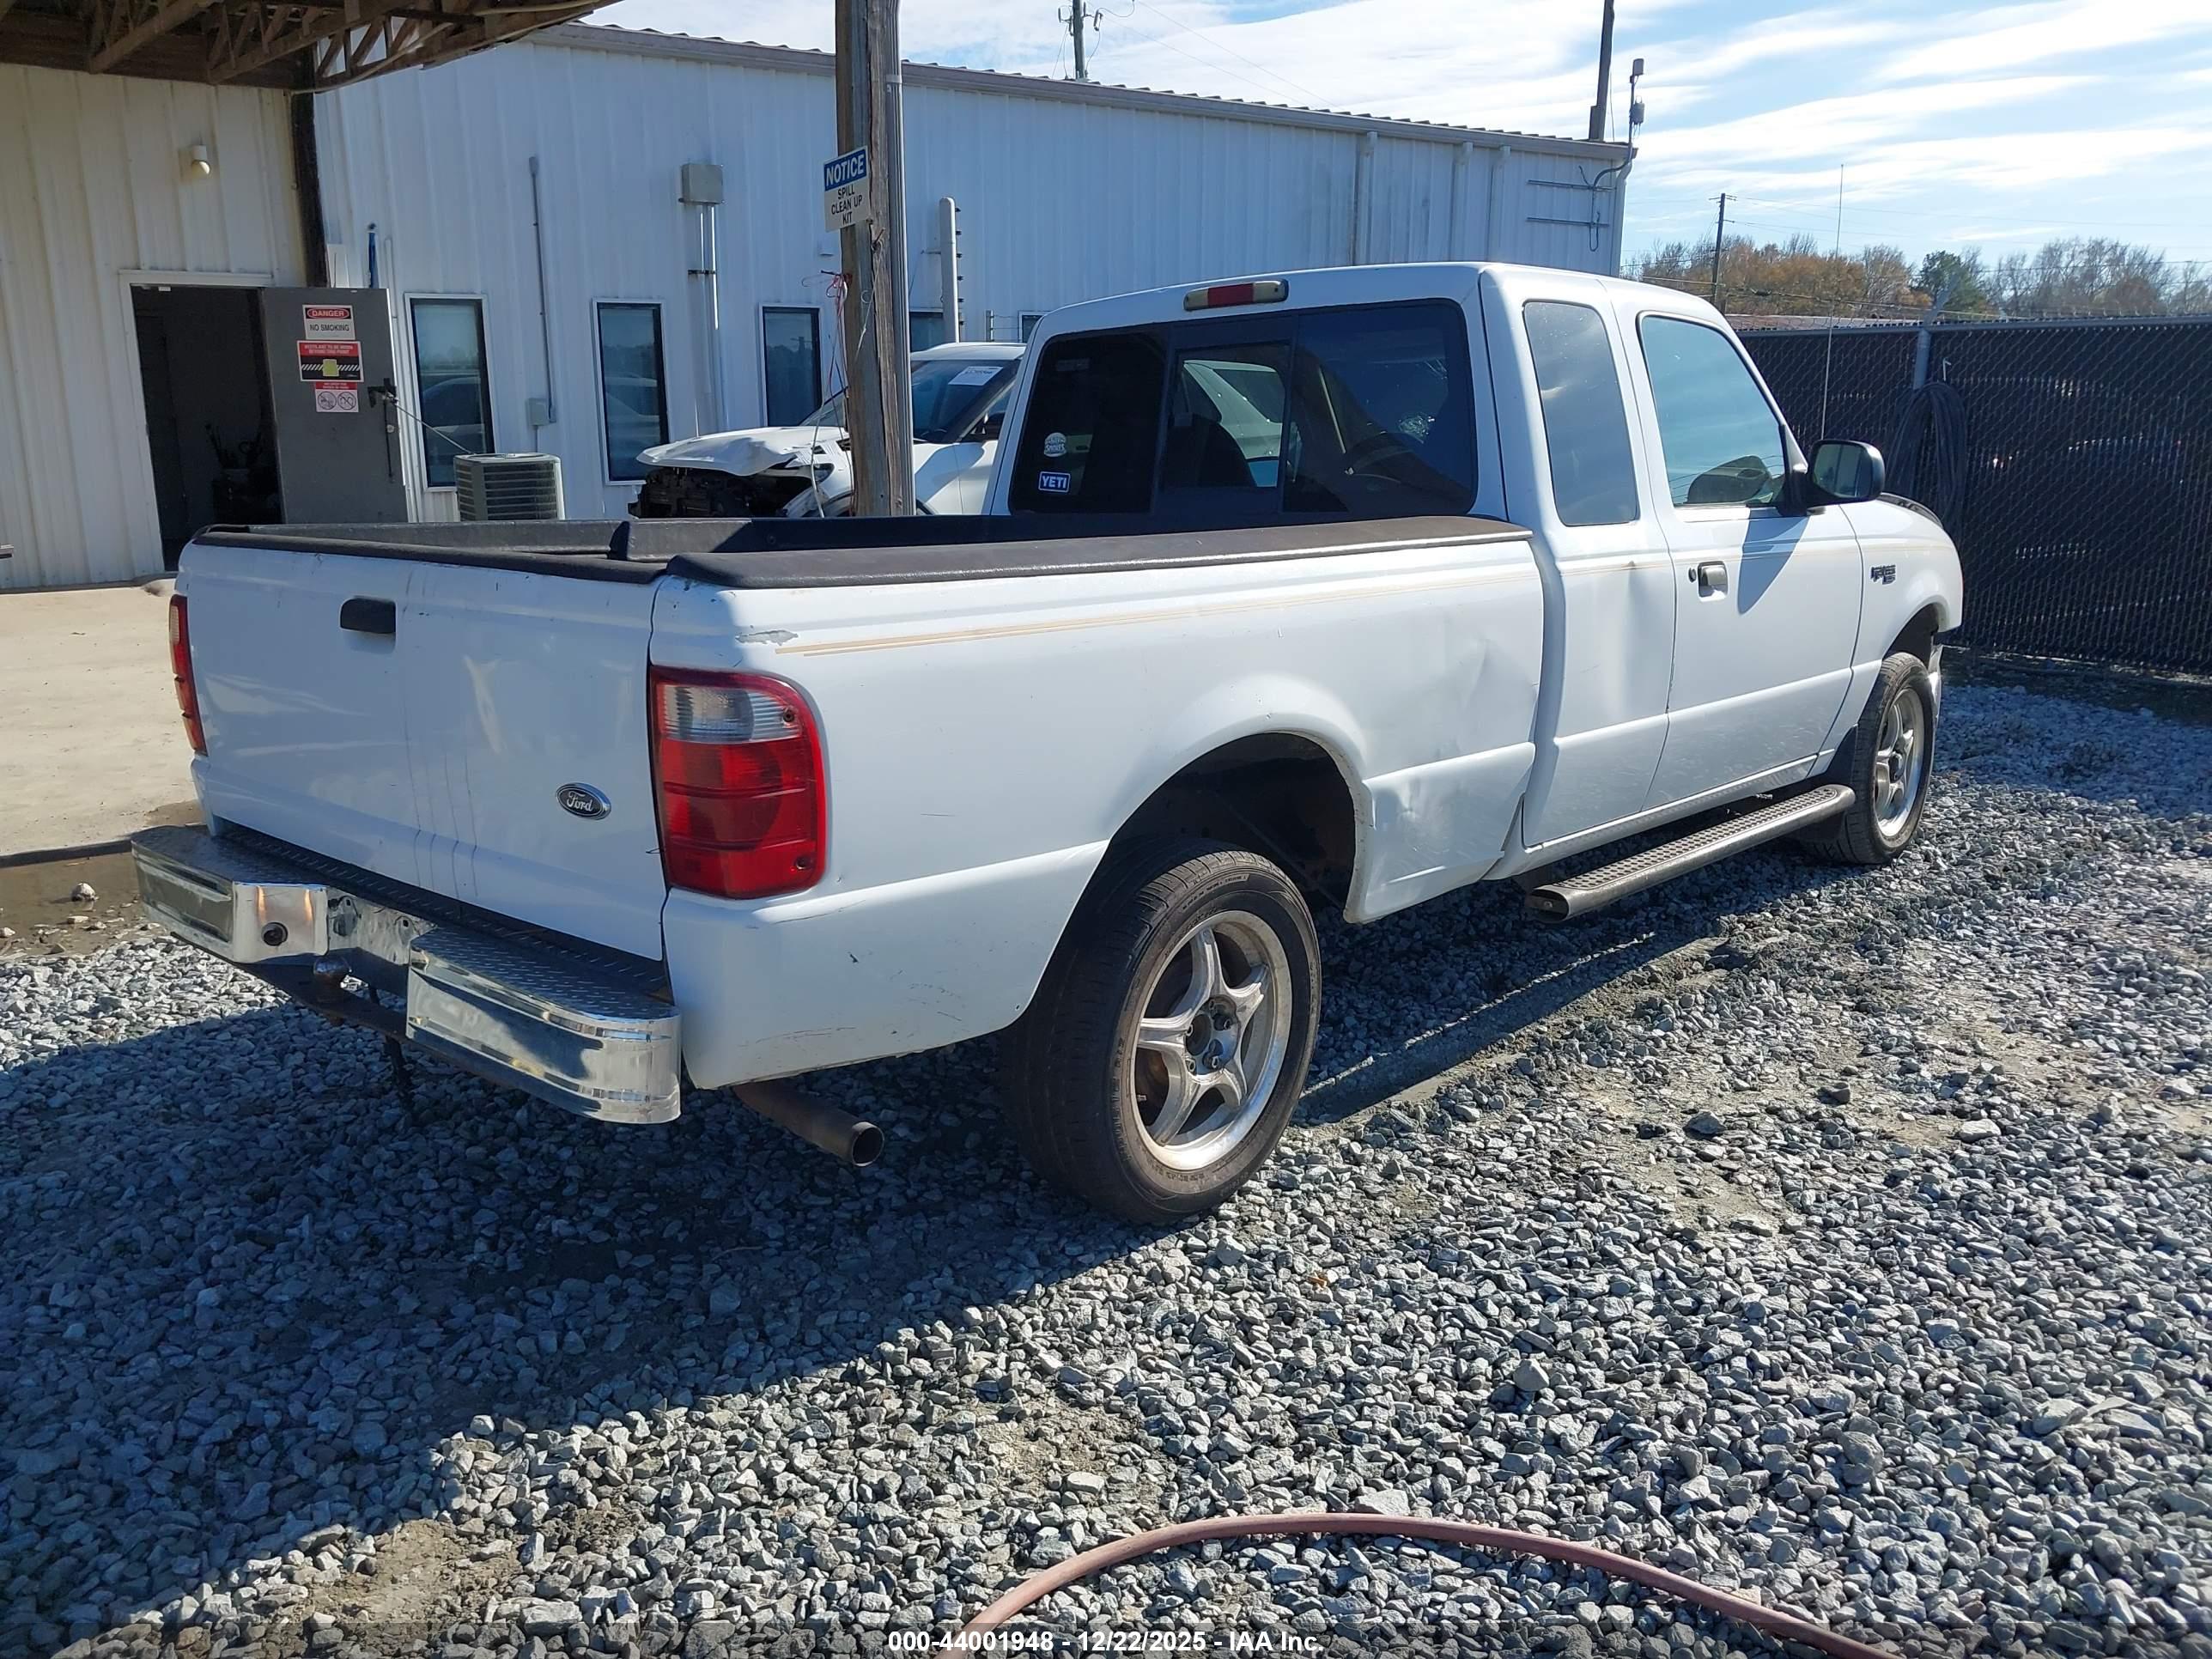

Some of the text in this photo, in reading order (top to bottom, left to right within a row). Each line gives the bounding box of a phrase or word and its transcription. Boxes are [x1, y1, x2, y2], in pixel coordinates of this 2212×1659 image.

[826, 154, 865, 186] NOTICE
[837, 184, 855, 199] SPILL
[830, 194, 863, 215] CLEAN UP
[842, 211, 853, 225] KIT
[1042, 475, 1067, 489] YETI
[567, 790, 593, 812] Ford
